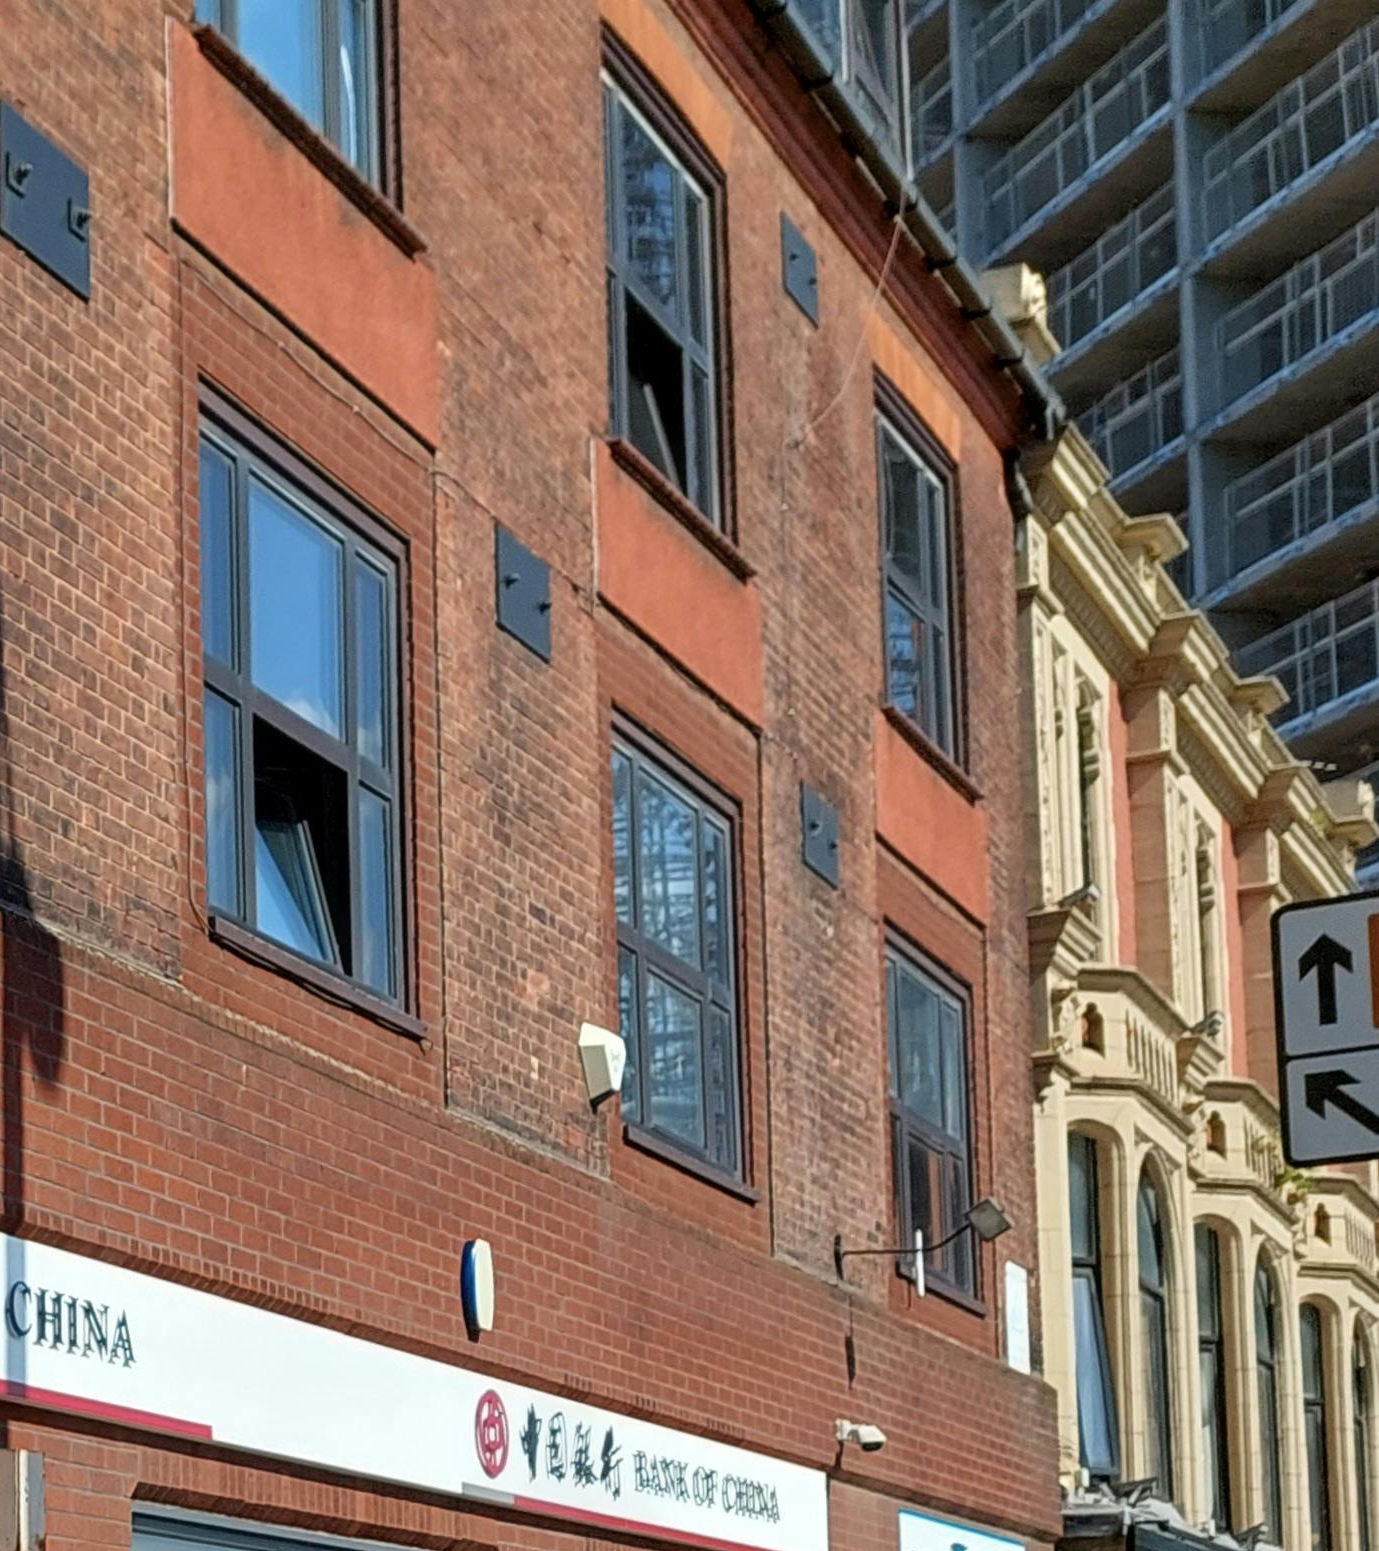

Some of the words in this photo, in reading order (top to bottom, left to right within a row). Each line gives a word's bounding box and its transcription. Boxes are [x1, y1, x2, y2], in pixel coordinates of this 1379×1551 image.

[4, 1279, 138, 1368] CHINA
[633, 1450, 689, 1502] BANK
[692, 1466, 718, 1508] OF
[722, 1474, 782, 1524] CHINA
